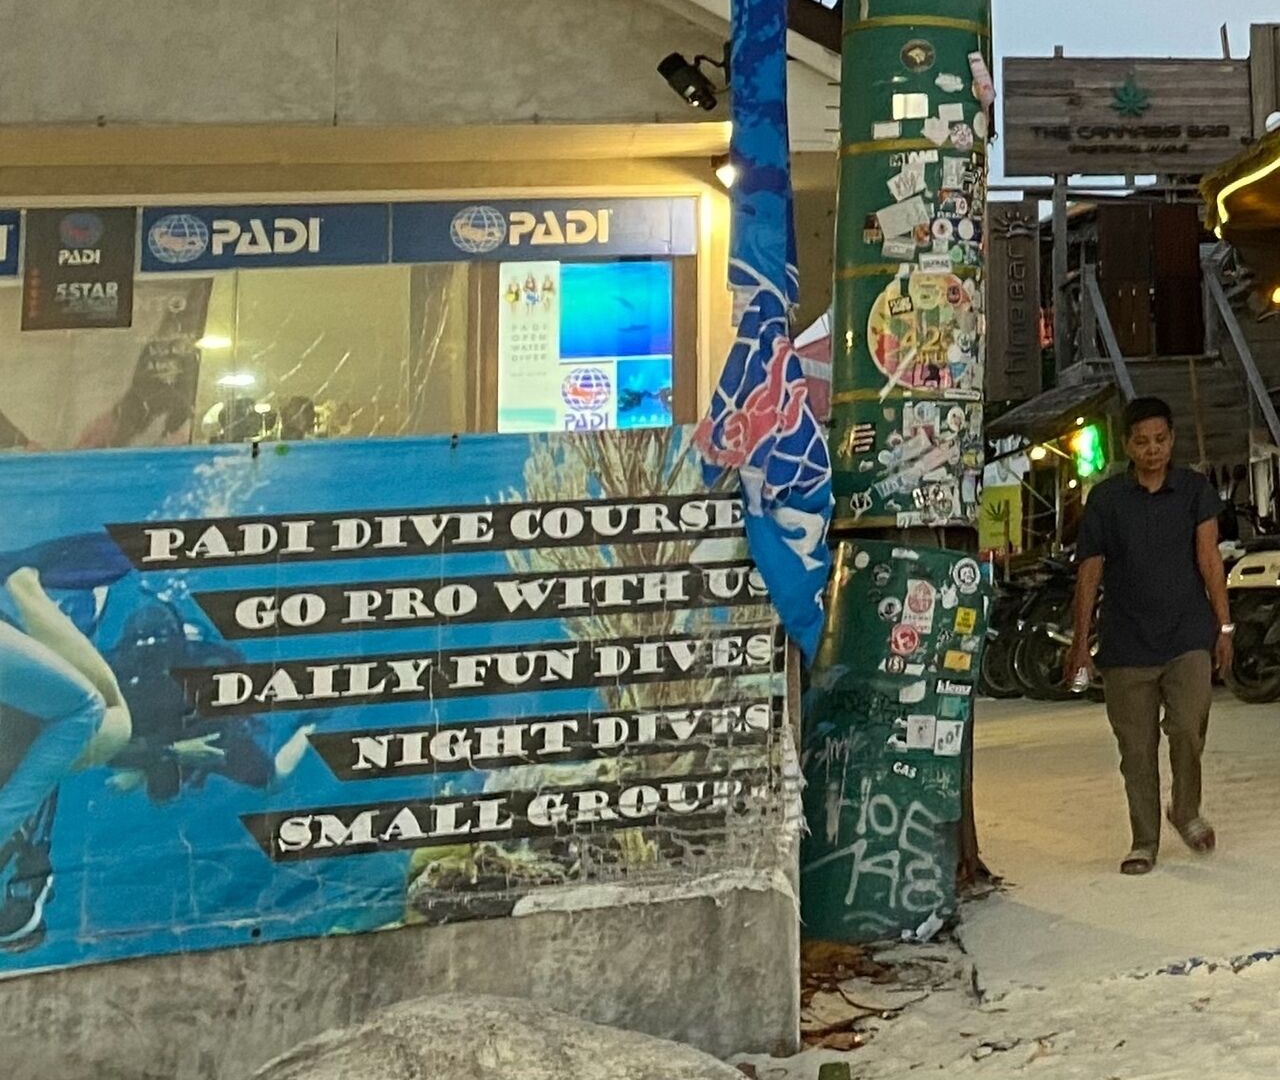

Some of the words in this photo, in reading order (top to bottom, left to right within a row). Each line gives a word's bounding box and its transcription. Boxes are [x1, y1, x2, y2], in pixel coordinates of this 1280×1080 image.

[212, 217, 321, 256] PADI
[509, 209, 610, 245] PADI
[58, 249, 101, 265] PADI
[68, 281, 118, 299] STAR
[564, 413, 609, 431] PADI
[143, 518, 316, 563] PADI
[332, 511, 496, 551] DIVE
[235, 593, 328, 630] GO
[340, 584, 479, 626] PRO
[493, 570, 693, 614] WITH
[209, 657, 433, 708] DAILY
[448, 649, 580, 691] FUN
[592, 632, 775, 681] DIVES
[351, 721, 580, 771] NIGHT
[591, 703, 773, 750] DIVES
[276, 800, 515, 853] SMALL
